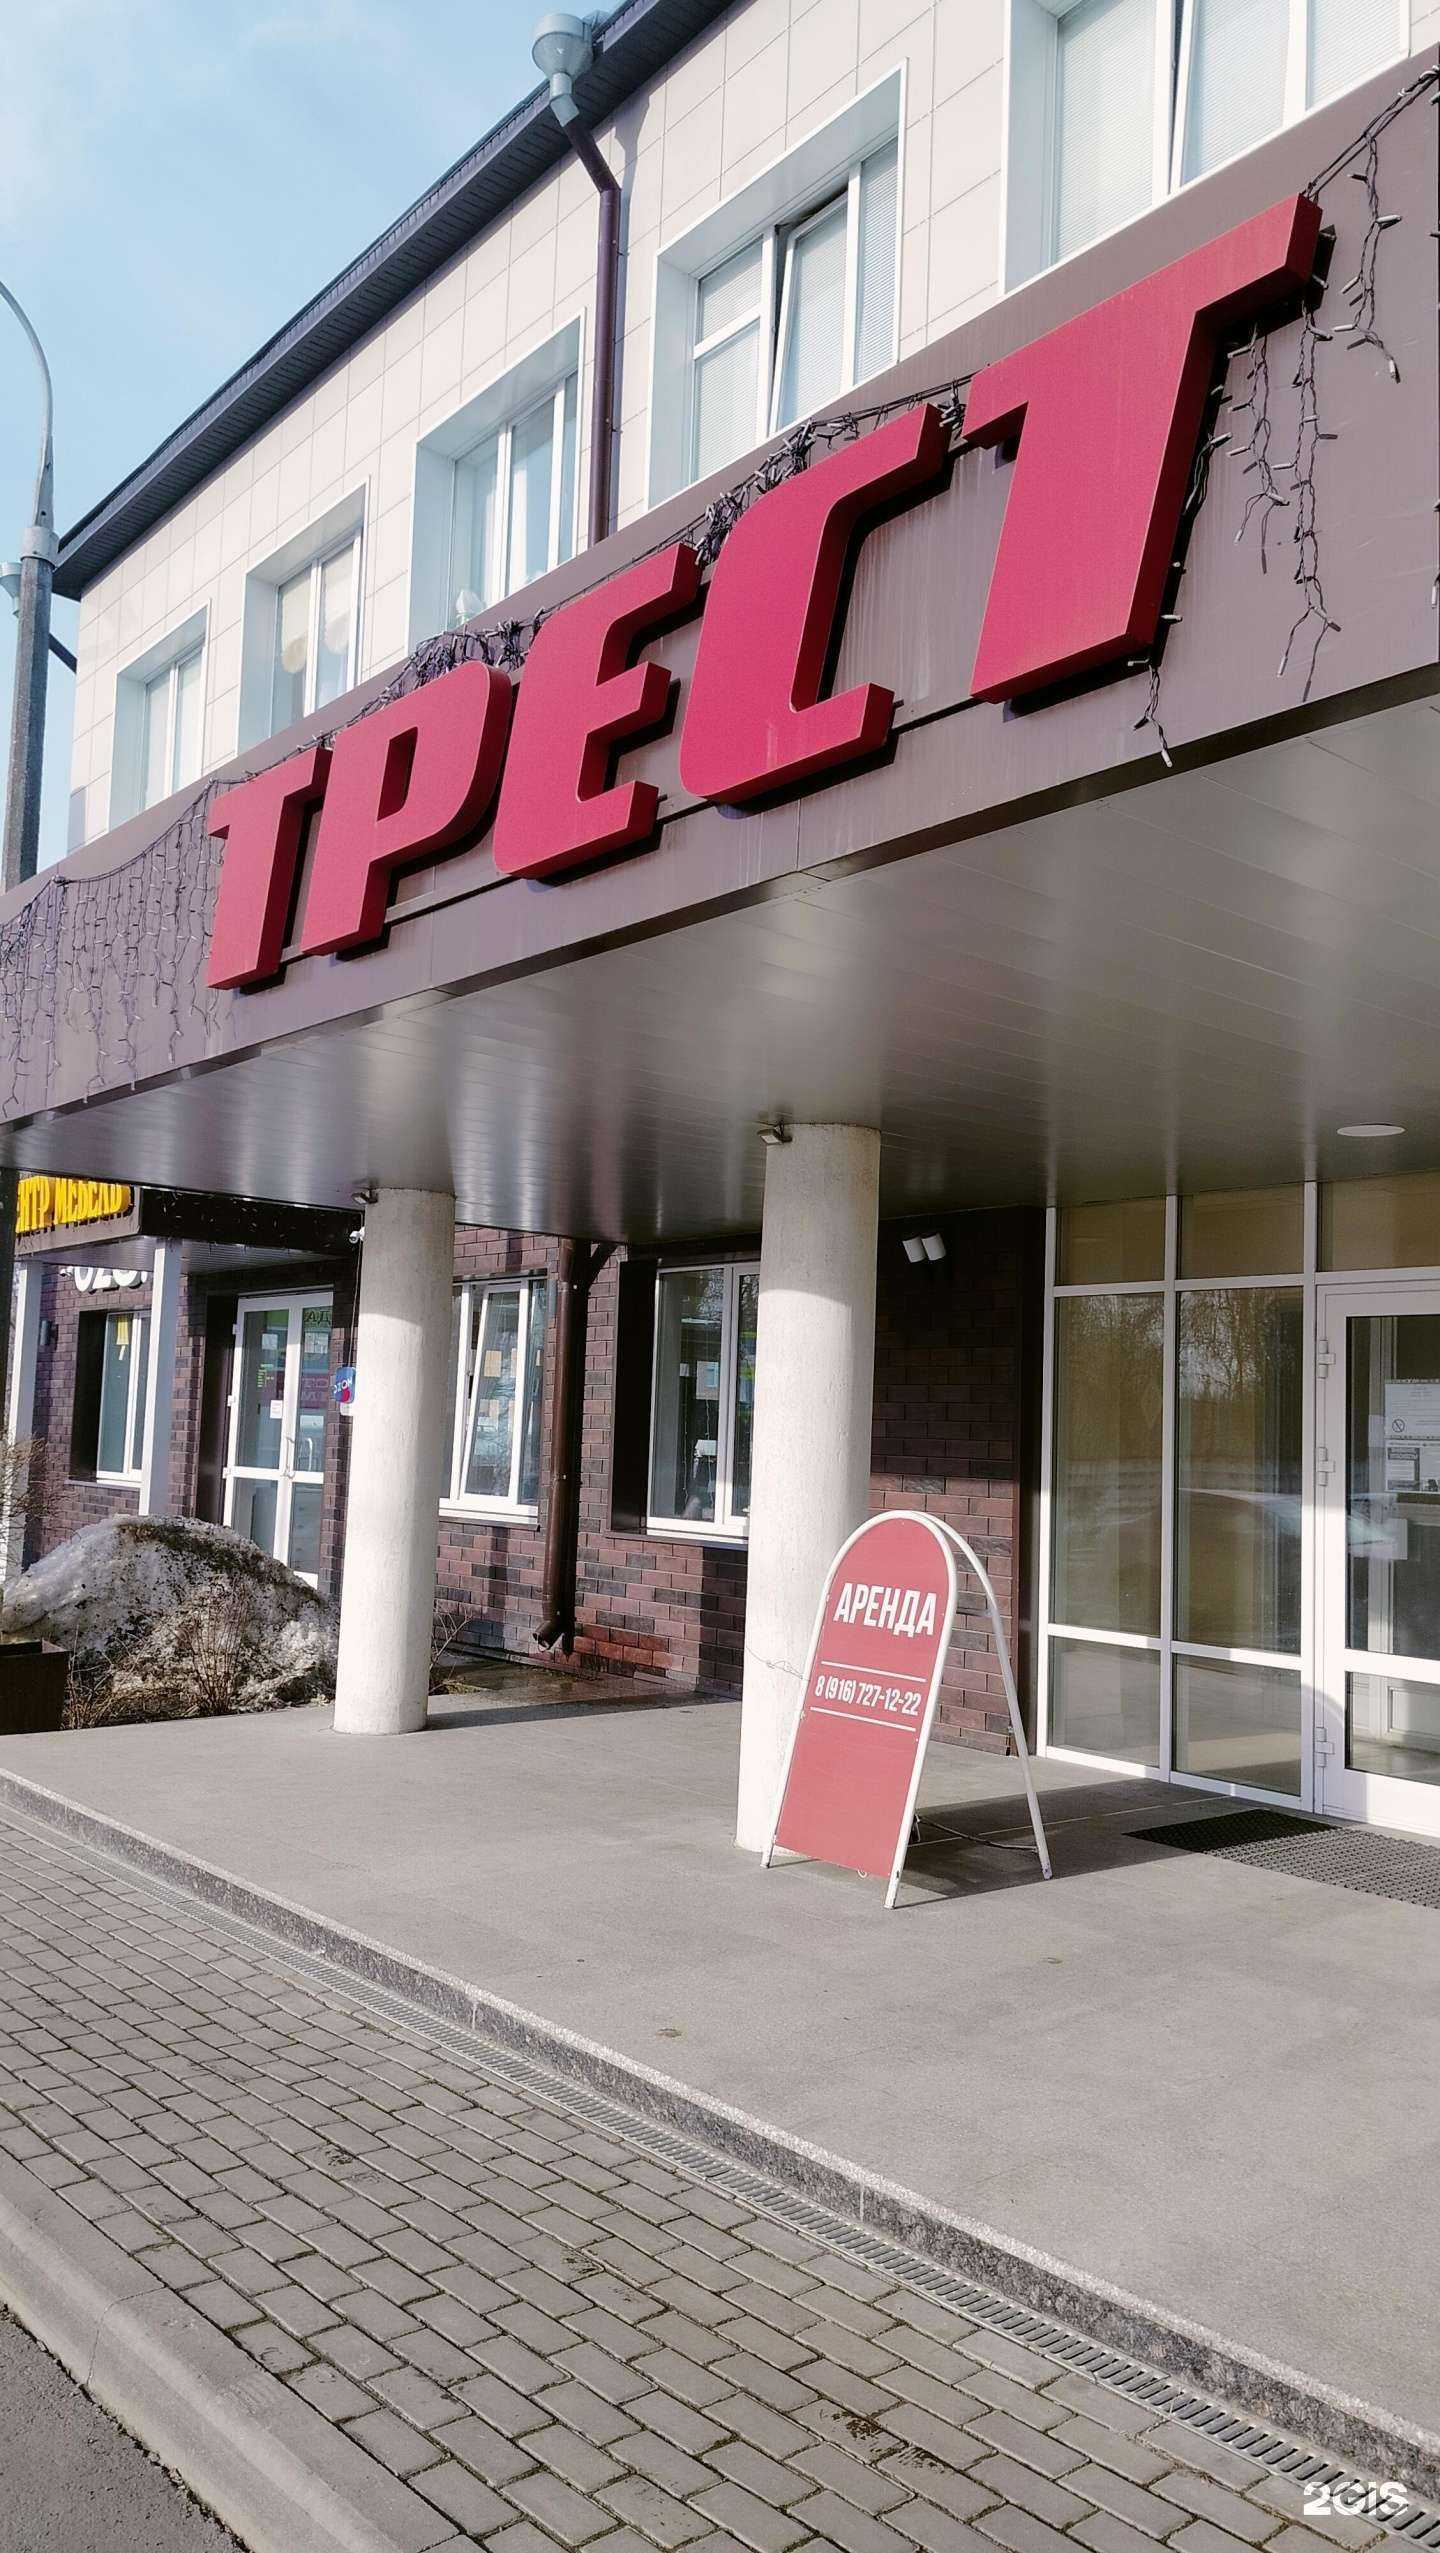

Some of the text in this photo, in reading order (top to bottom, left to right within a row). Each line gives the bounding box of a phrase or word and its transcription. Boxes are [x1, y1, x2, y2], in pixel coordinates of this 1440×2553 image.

[207, 194, 1323, 990] ТРЕСТ
[16, 1176, 51, 1233] НТР
[833, 1582, 937, 1638] АРЕНДА
[814, 1675, 922, 1716] 8 (916) 727-12-22
